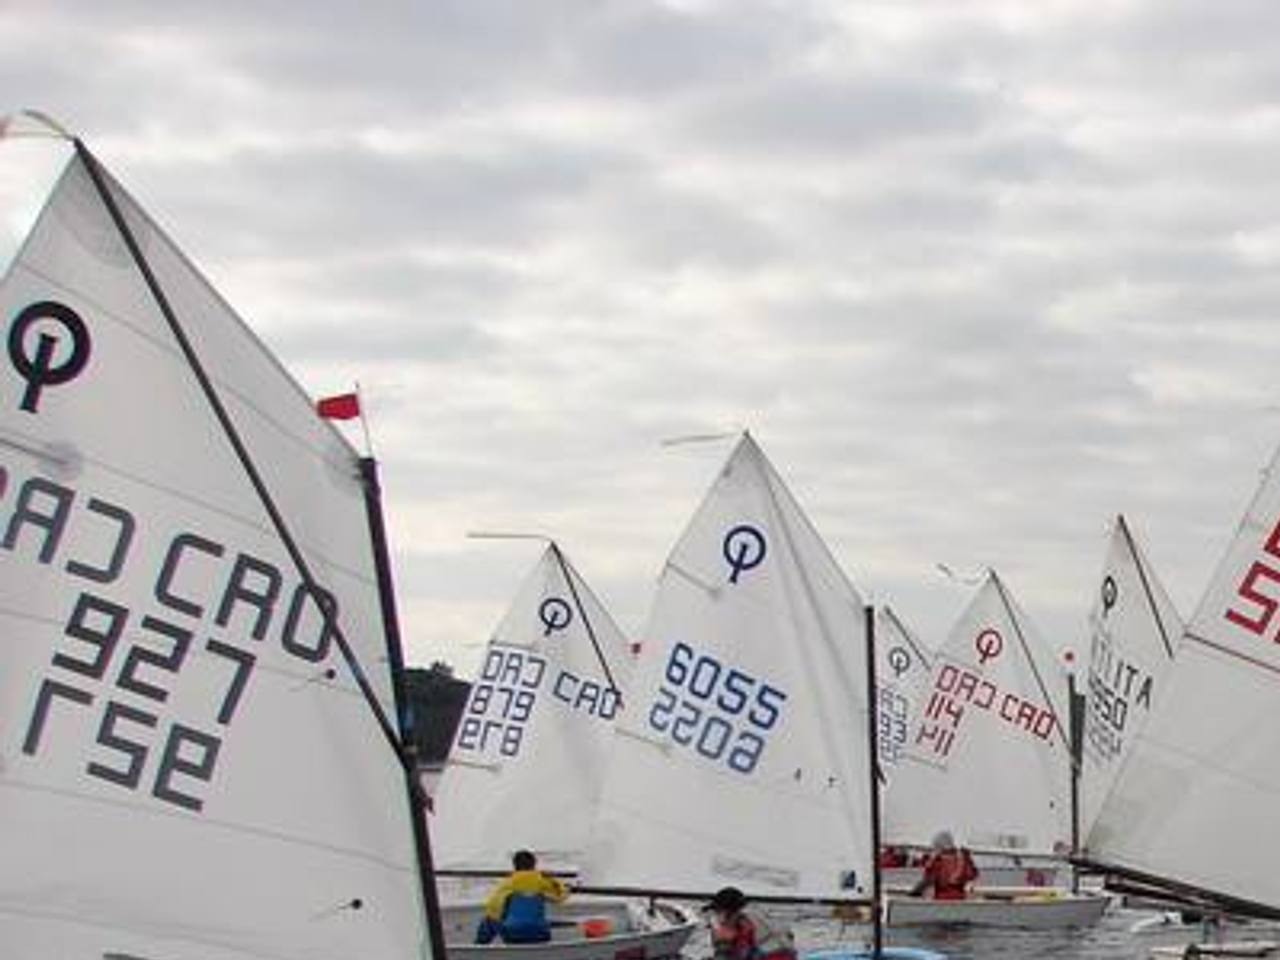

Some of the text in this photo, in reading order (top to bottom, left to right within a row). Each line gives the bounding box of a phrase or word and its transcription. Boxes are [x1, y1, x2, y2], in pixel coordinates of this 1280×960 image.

[155, 533, 339, 663] CRO
[51, 592, 257, 725] 927
[470, 684, 535, 722] 879
[553, 671, 620, 720] CRO
[665, 642, 787, 730] 6055
[925, 692, 964, 728] 114
[1113, 659, 1152, 711] ITA
[1000, 694, 1057, 740] CRO
